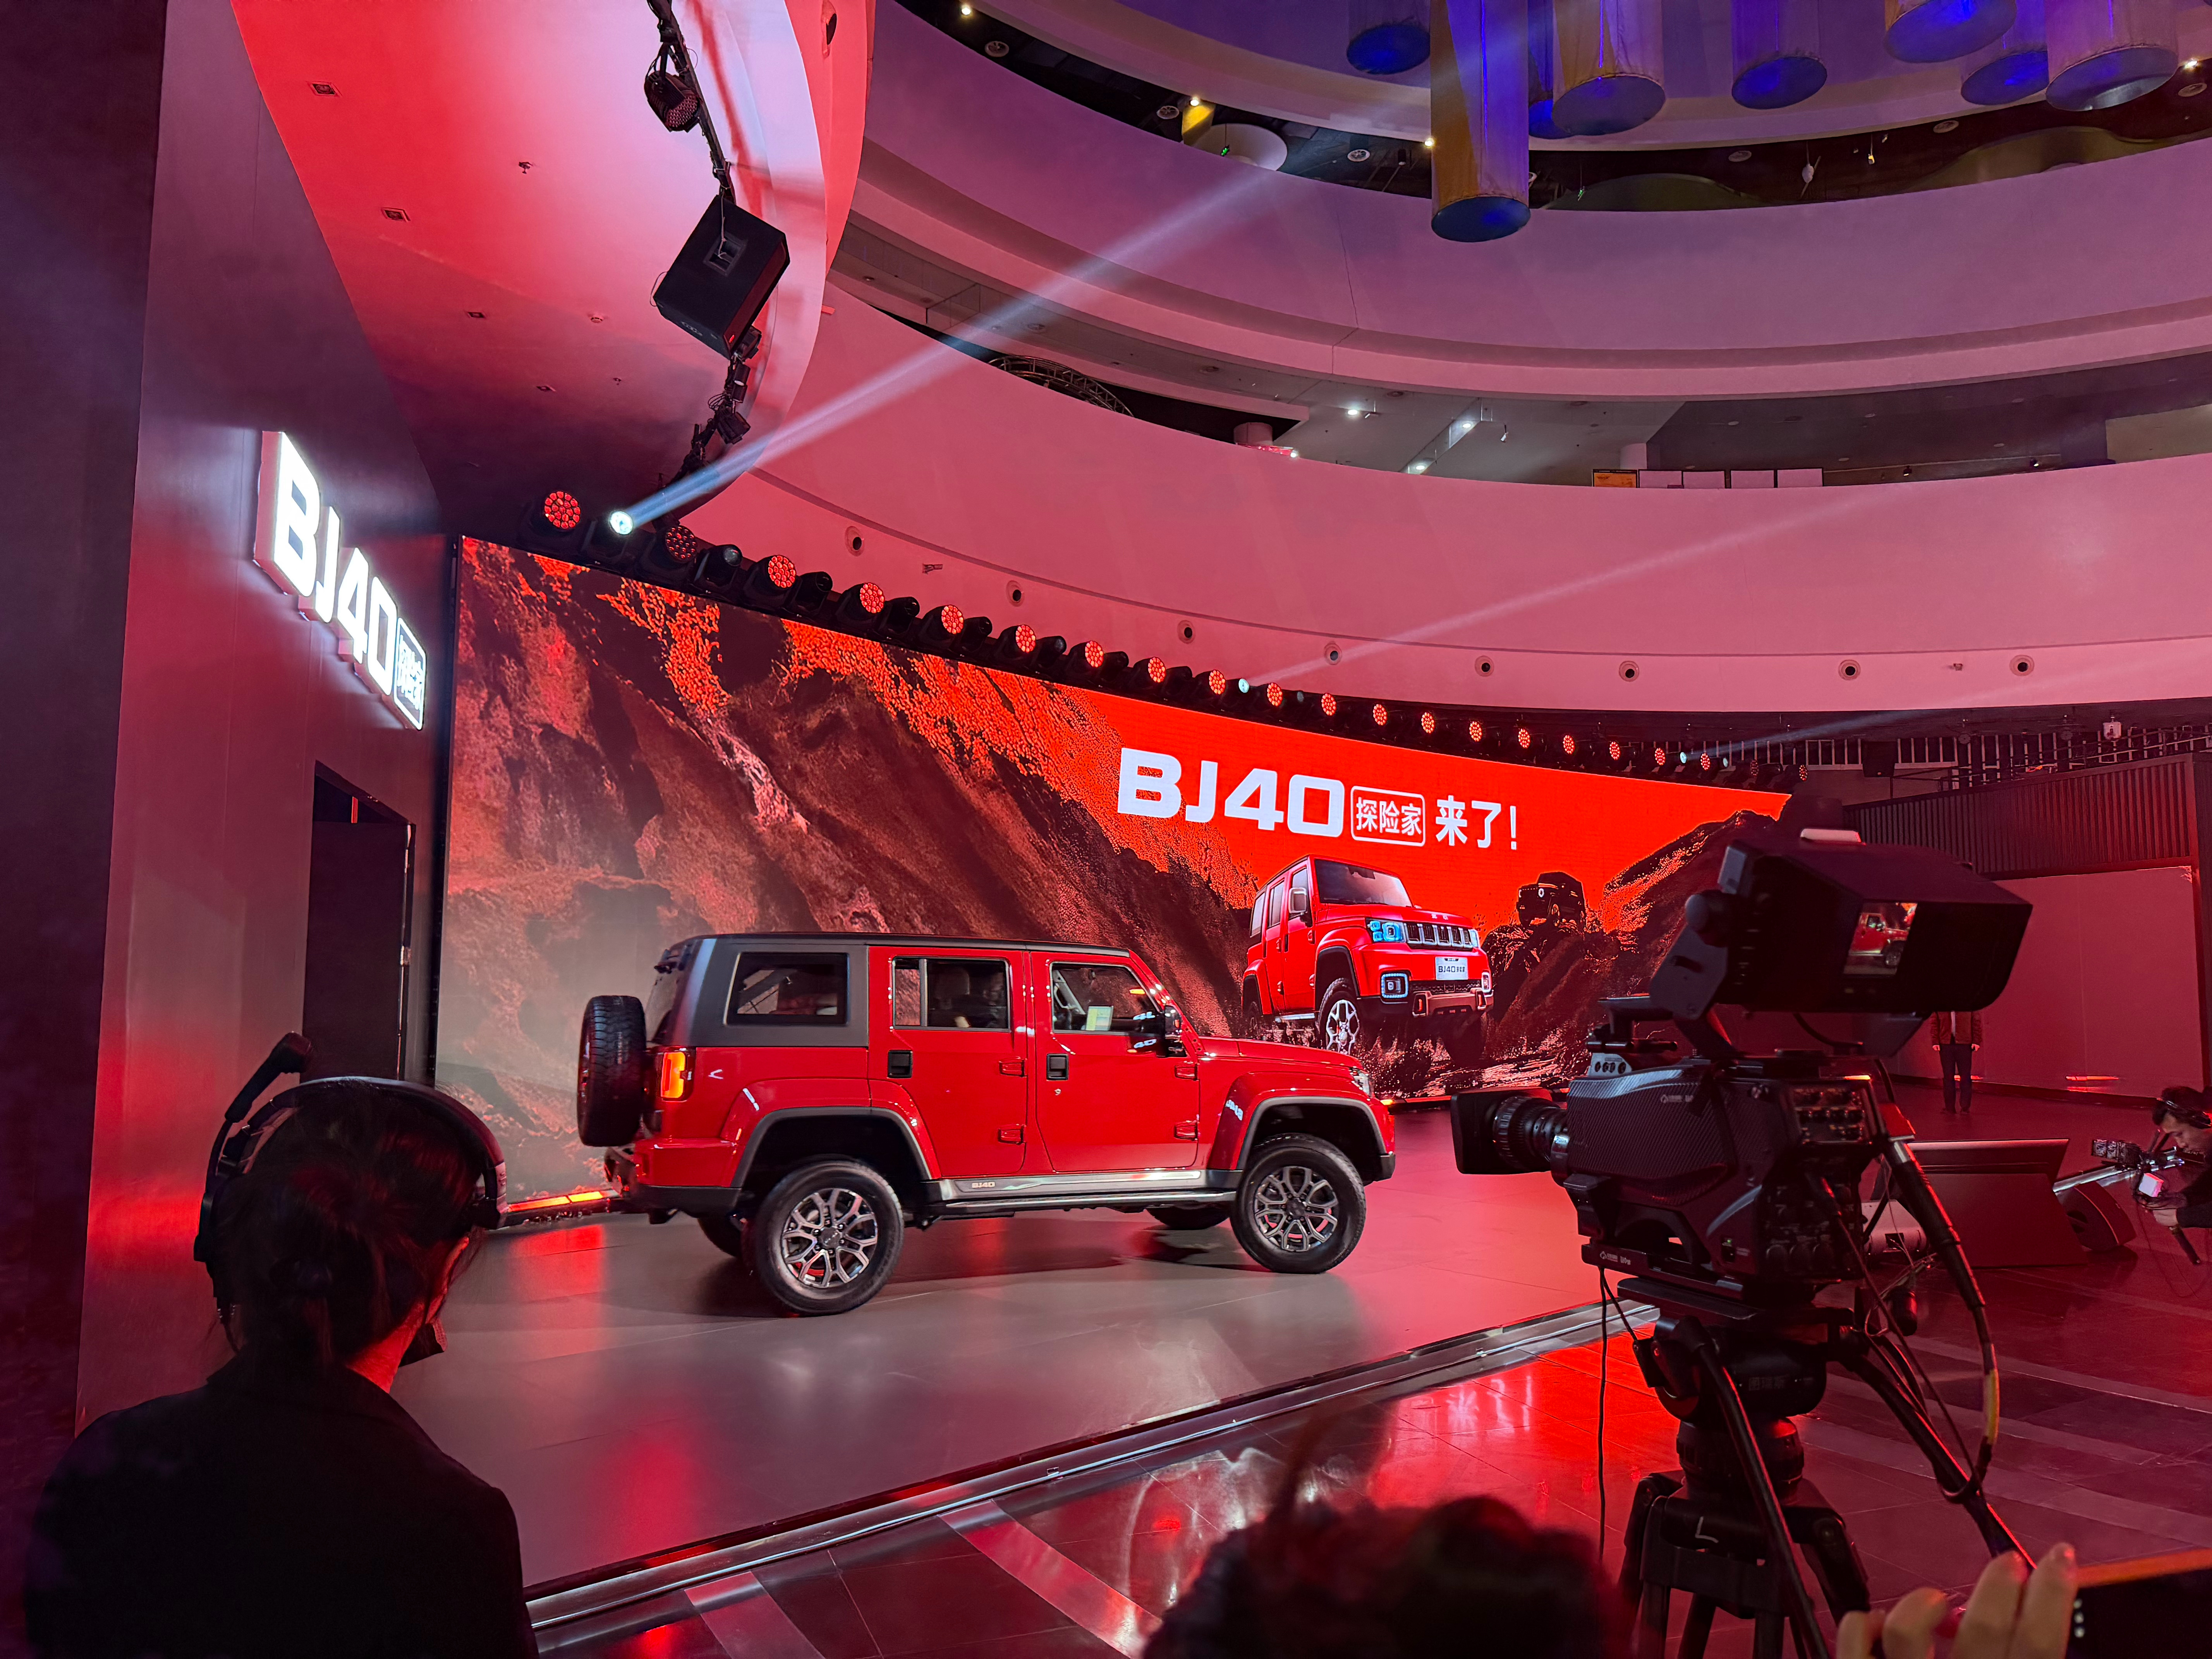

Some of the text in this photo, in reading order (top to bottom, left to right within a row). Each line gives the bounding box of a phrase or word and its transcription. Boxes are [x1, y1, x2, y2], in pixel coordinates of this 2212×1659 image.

[273, 431, 398, 696] BJ40
[1117, 747, 1517, 850] BJ40 探险家 来了!
